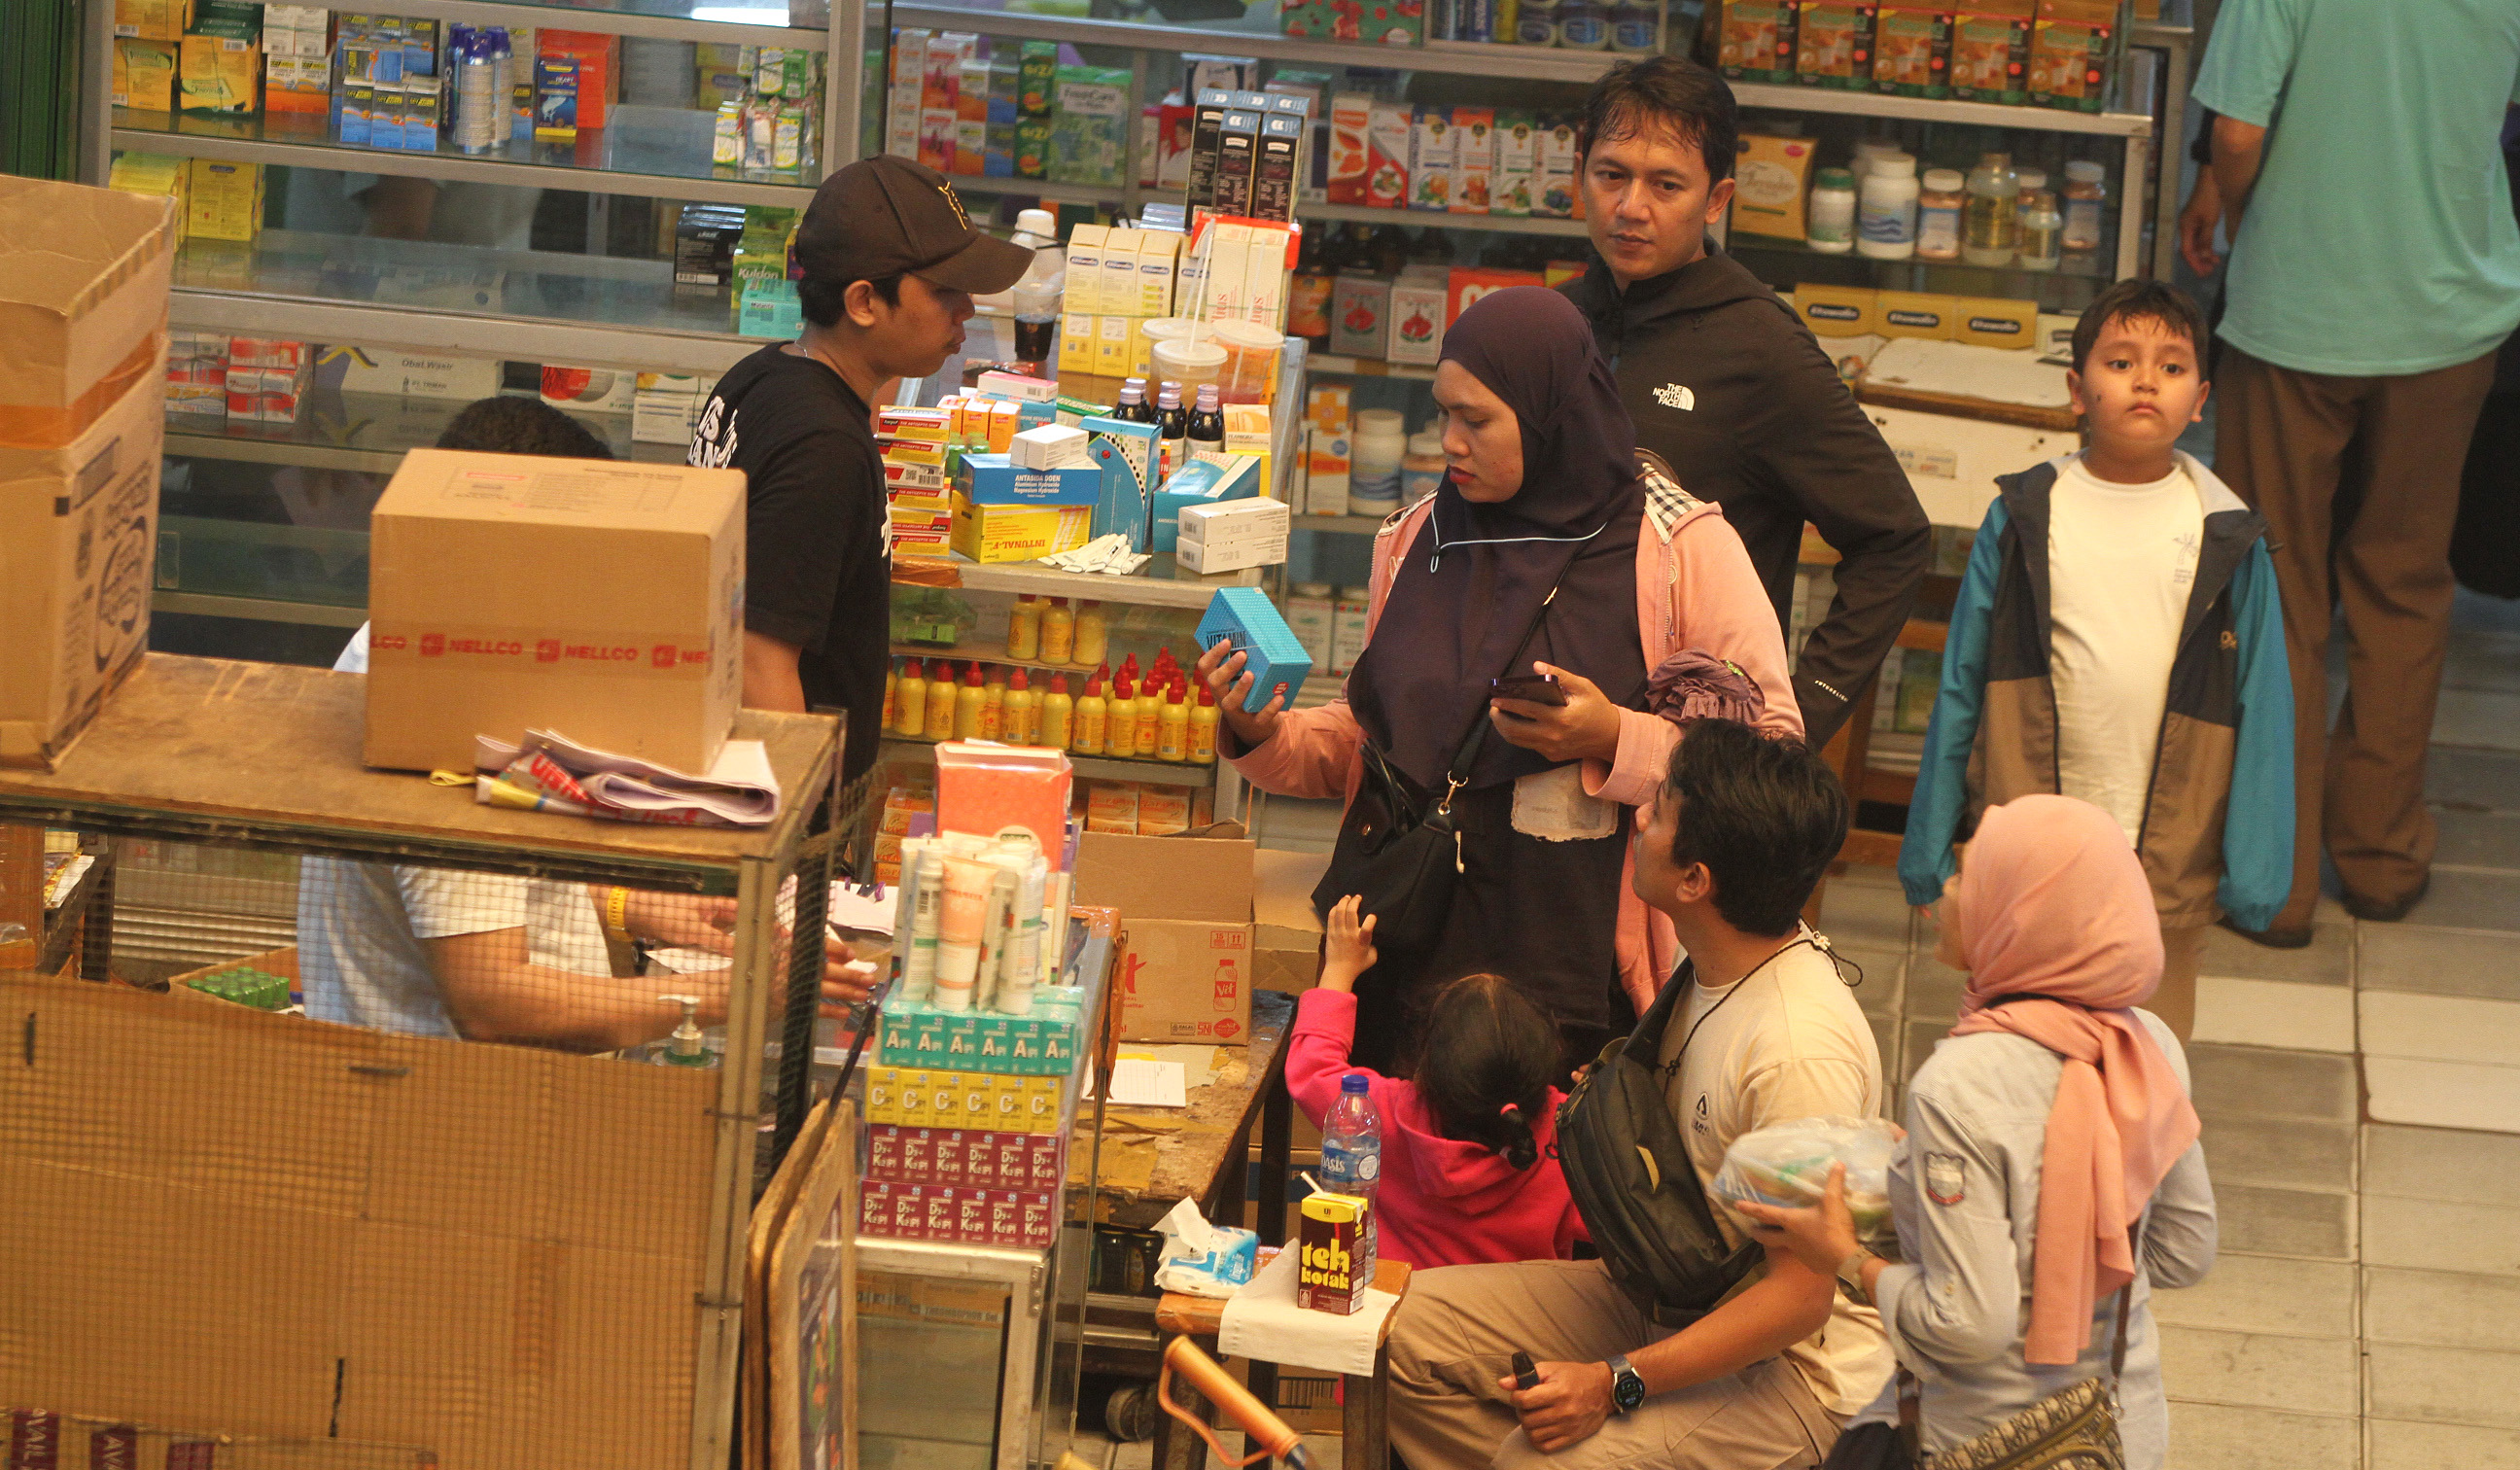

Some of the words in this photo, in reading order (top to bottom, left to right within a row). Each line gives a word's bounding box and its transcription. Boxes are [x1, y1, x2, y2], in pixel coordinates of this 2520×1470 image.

[738, 265, 779, 280] Kuldon
[1653, 387, 1680, 401] NORTH
[1666, 382, 1683, 393] THE
[1658, 396, 1679, 408] FACE
[449, 639, 523, 656] NELLCO
[565, 645, 639, 661] NELLCO
[1216, 982, 1236, 997] Vit
[886, 1030, 899, 1049] A
[917, 1032, 931, 1051] A
[949, 1035, 963, 1054] A
[982, 1037, 996, 1056] A
[1013, 1038, 1027, 1058] A
[1045, 1039, 1059, 1059] A
[871, 1087, 885, 1105] C
[902, 1090, 917, 1108] C
[934, 1092, 949, 1110] C
[967, 1093, 980, 1111] C
[999, 1095, 1013, 1113] C
[1032, 1097, 1045, 1114] C
[1302, 1239, 1350, 1273] teh
[1301, 1267, 1349, 1290] kotak
